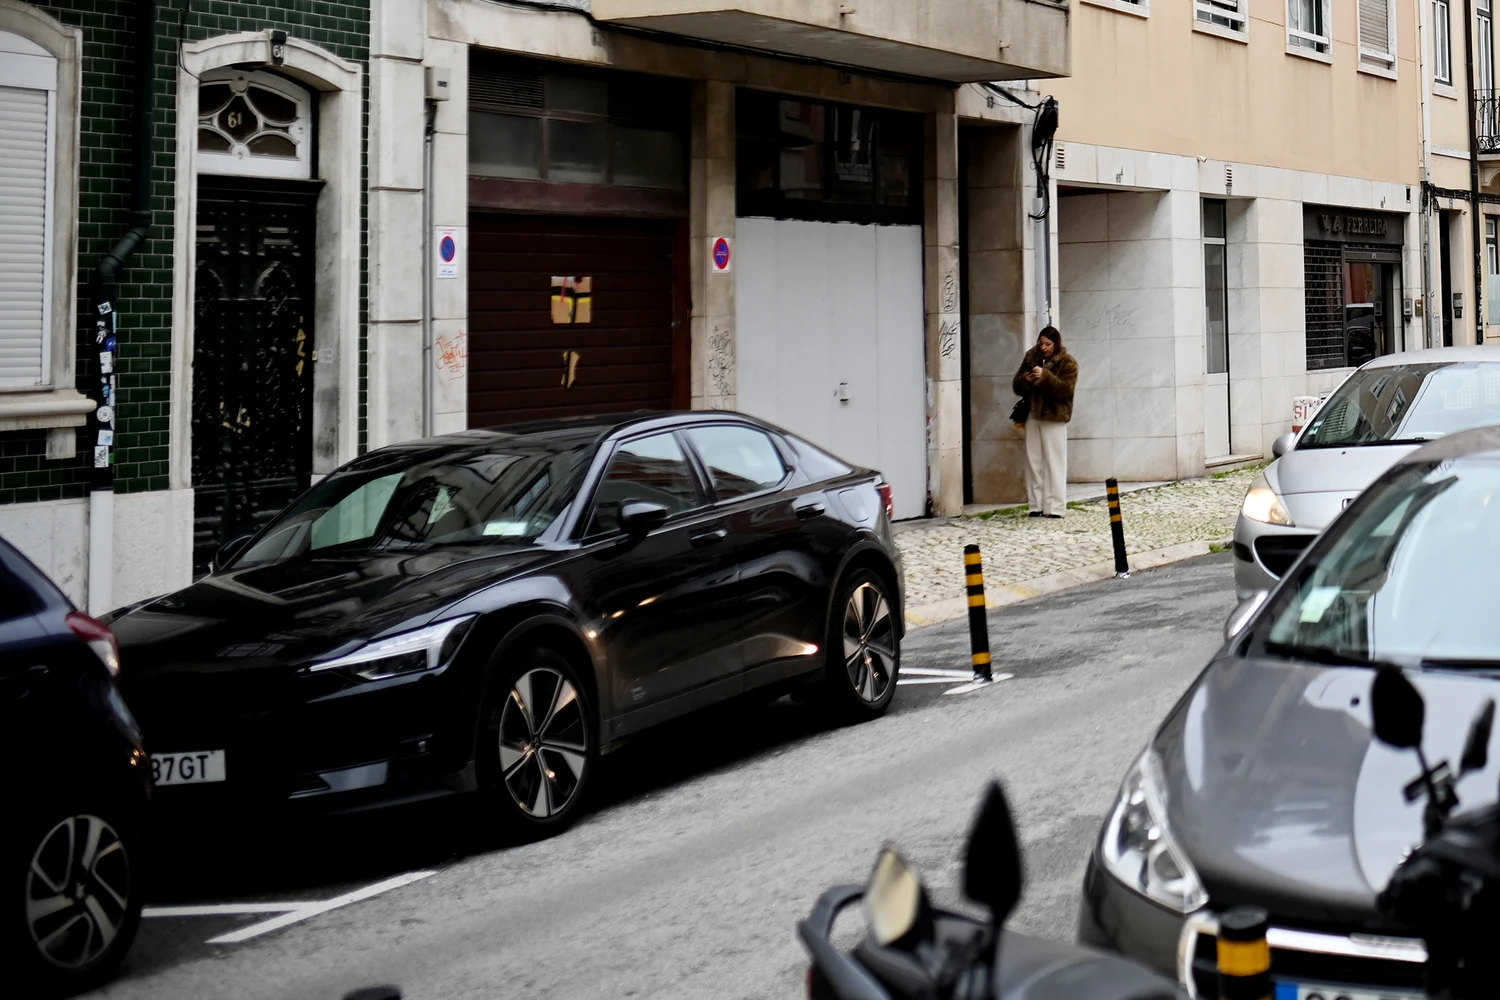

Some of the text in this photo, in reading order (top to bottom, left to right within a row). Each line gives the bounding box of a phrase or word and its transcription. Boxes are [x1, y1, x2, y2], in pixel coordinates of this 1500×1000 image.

[272, 44, 284, 59] 61
[227, 111, 242, 128] 61
[1347, 216, 1389, 235] FERREIRA
